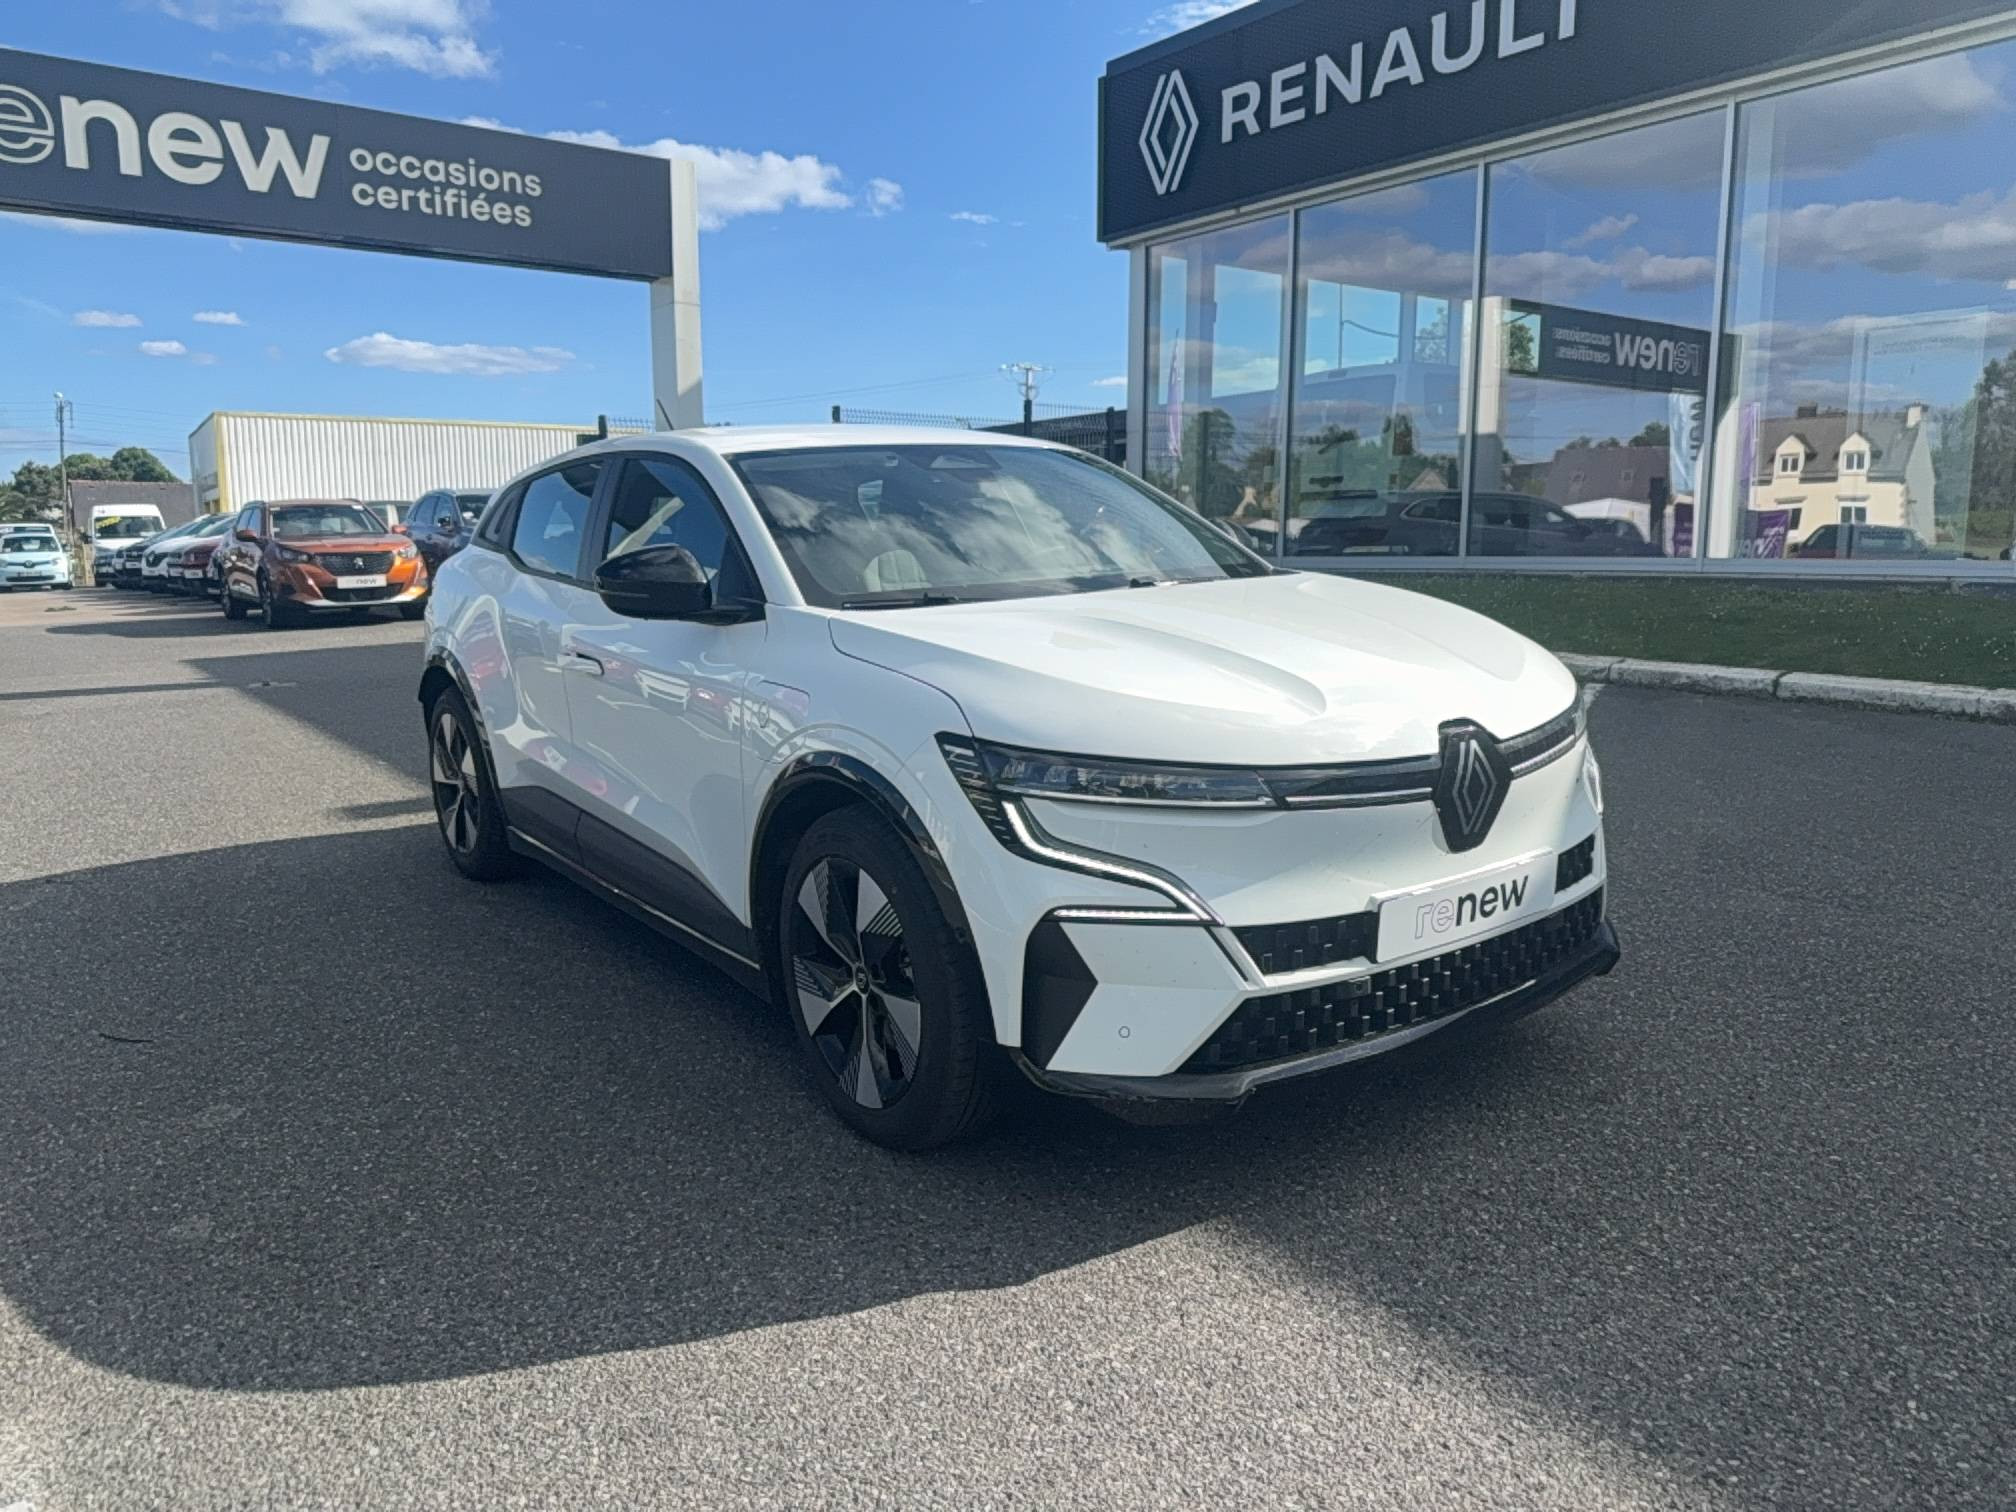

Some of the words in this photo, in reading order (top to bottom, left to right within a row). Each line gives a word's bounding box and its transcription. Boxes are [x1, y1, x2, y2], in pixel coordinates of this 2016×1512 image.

[350, 148, 543, 197] occasions
[352, 183, 533, 227] certifiées
[1414, 875, 1529, 940] renew
